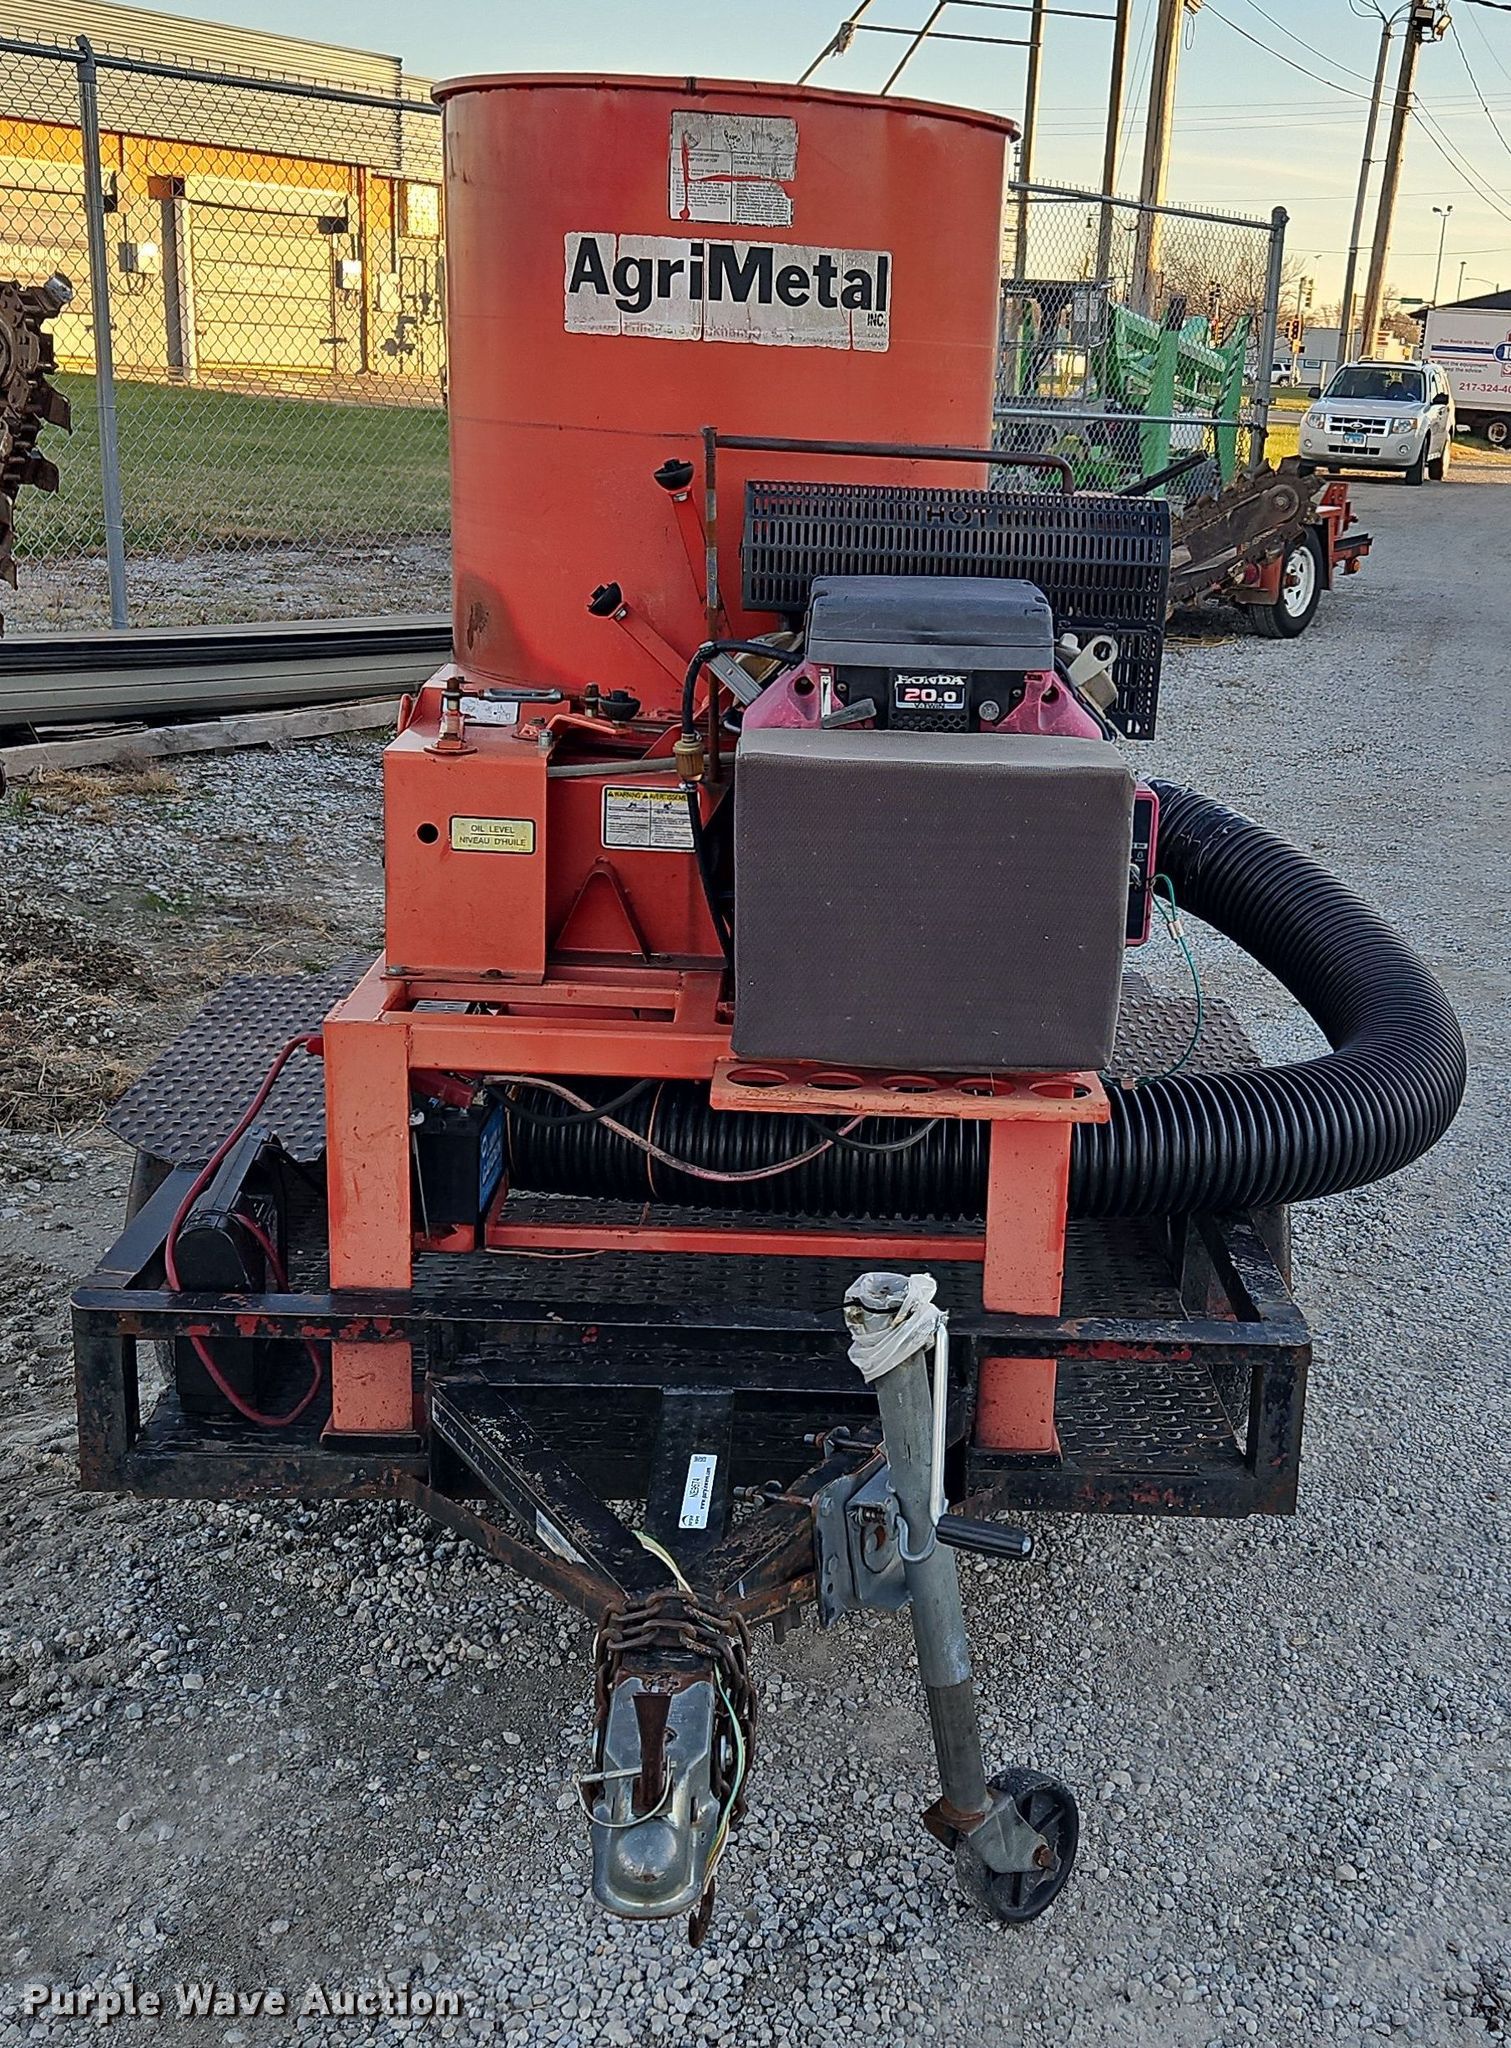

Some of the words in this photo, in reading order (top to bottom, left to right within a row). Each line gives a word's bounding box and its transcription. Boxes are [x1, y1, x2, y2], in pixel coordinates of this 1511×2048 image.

[569, 237, 888, 313] AgriMetal
[926, 505, 992, 528] HOT
[896, 674, 967, 686] HONDA
[904, 688, 957, 702] 20.0
[471, 824, 485, 834] OIL
[489, 826, 515, 835] LEVEL
[459, 836, 490, 845] NIVEAU
[494, 837, 526, 847] D'HUILE
